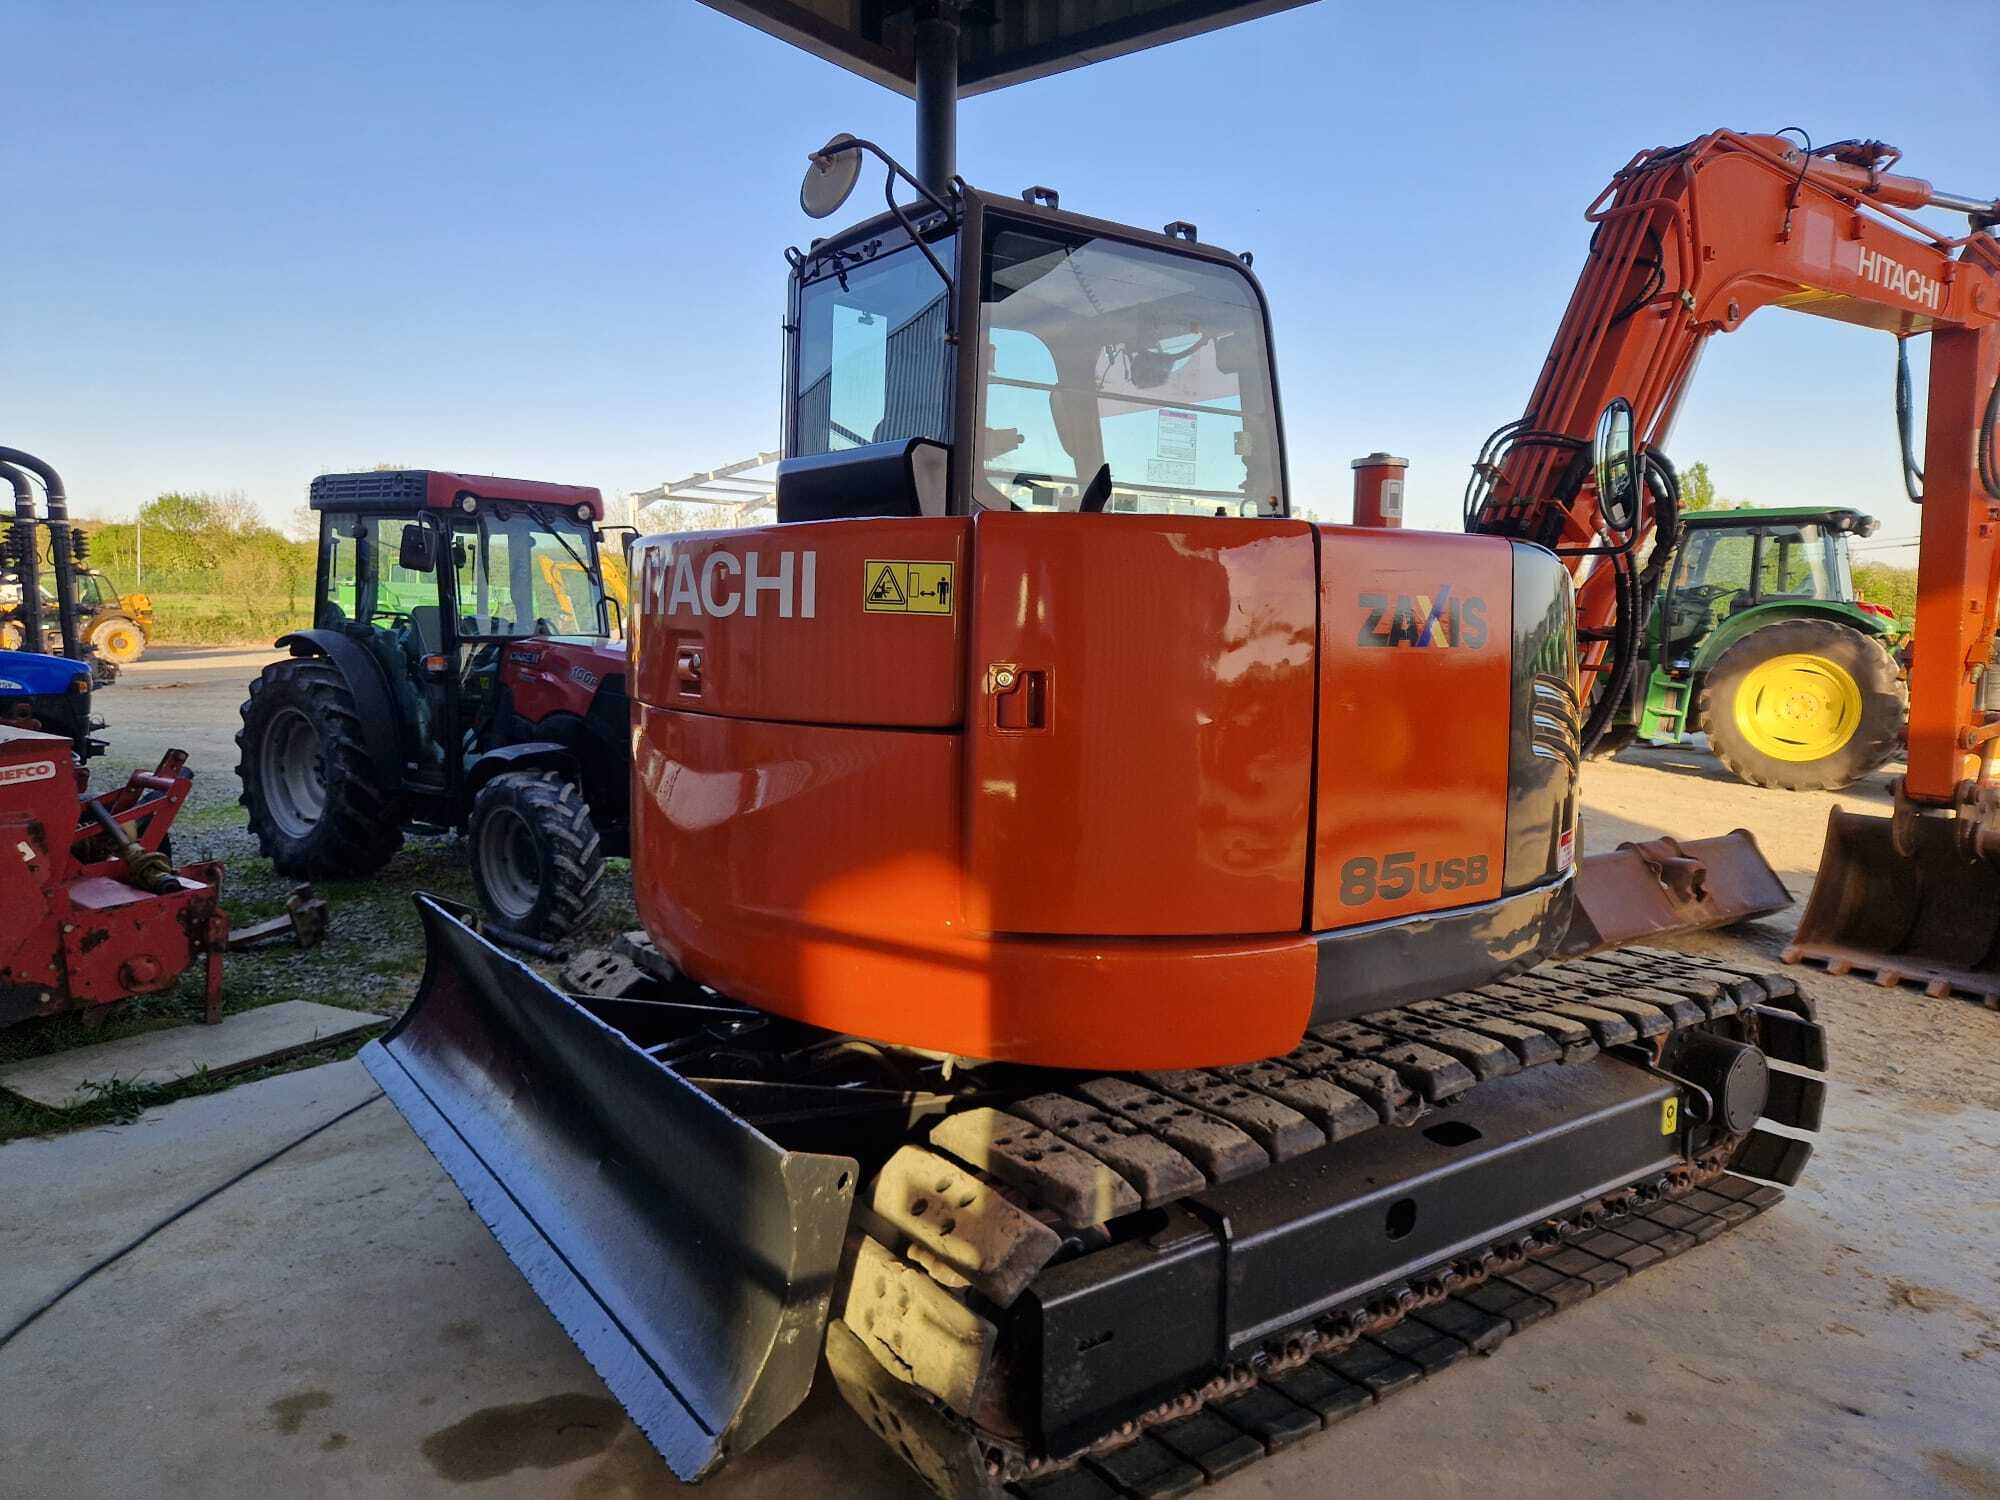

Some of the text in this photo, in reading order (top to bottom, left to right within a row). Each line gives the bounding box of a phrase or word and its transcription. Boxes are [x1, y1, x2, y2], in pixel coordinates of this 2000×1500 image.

[1857, 246, 1940, 310] HITACHI
[1357, 583, 1488, 650] ZAXIS
[0, 765, 49, 781] EFCO
